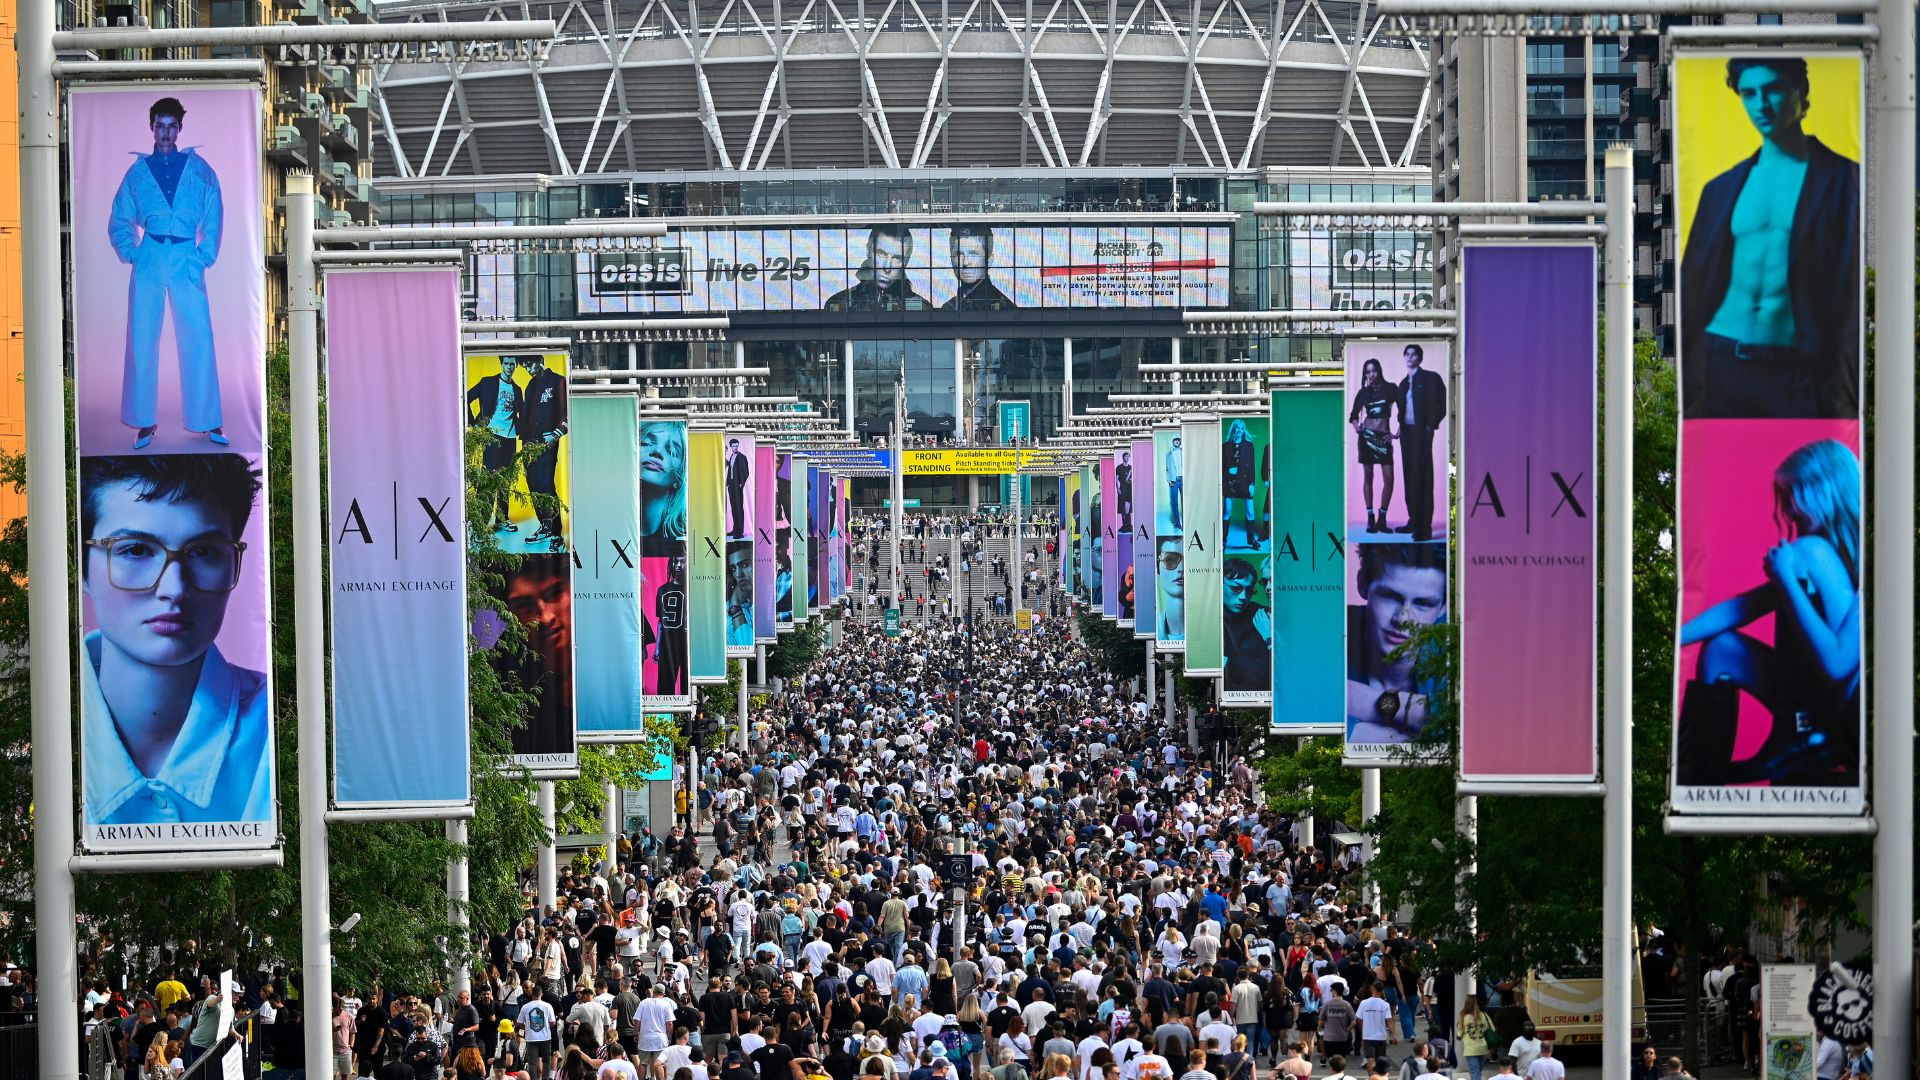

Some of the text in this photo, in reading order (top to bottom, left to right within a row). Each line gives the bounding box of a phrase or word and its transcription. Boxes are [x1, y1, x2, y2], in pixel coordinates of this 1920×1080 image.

[1093, 249, 1140, 257] ASHCROFT
[600, 258, 682, 283] oasis
[705, 258, 758, 282] live
[1132, 263, 1151, 272] OUT
[915, 452, 943, 460] FRONT
[908, 464, 951, 472] STANDING
[973, 460, 1000, 468] Standing
[1472, 555, 1585, 566] ARMANI EXCHANGE
[339, 581, 457, 593] ARMANI EXCHANGE
[661, 590, 685, 629] 9
[1352, 744, 1389, 752] ARMANI
[519, 754, 569, 763] EXCHANGE
[1684, 789, 1848, 803] ARMANI EXCHANGE
[95, 823, 263, 840] ARMANI EXCHANGE
[1542, 1016, 1552, 1024] ICE
[1554, 1016, 1580, 1024] CREAM
